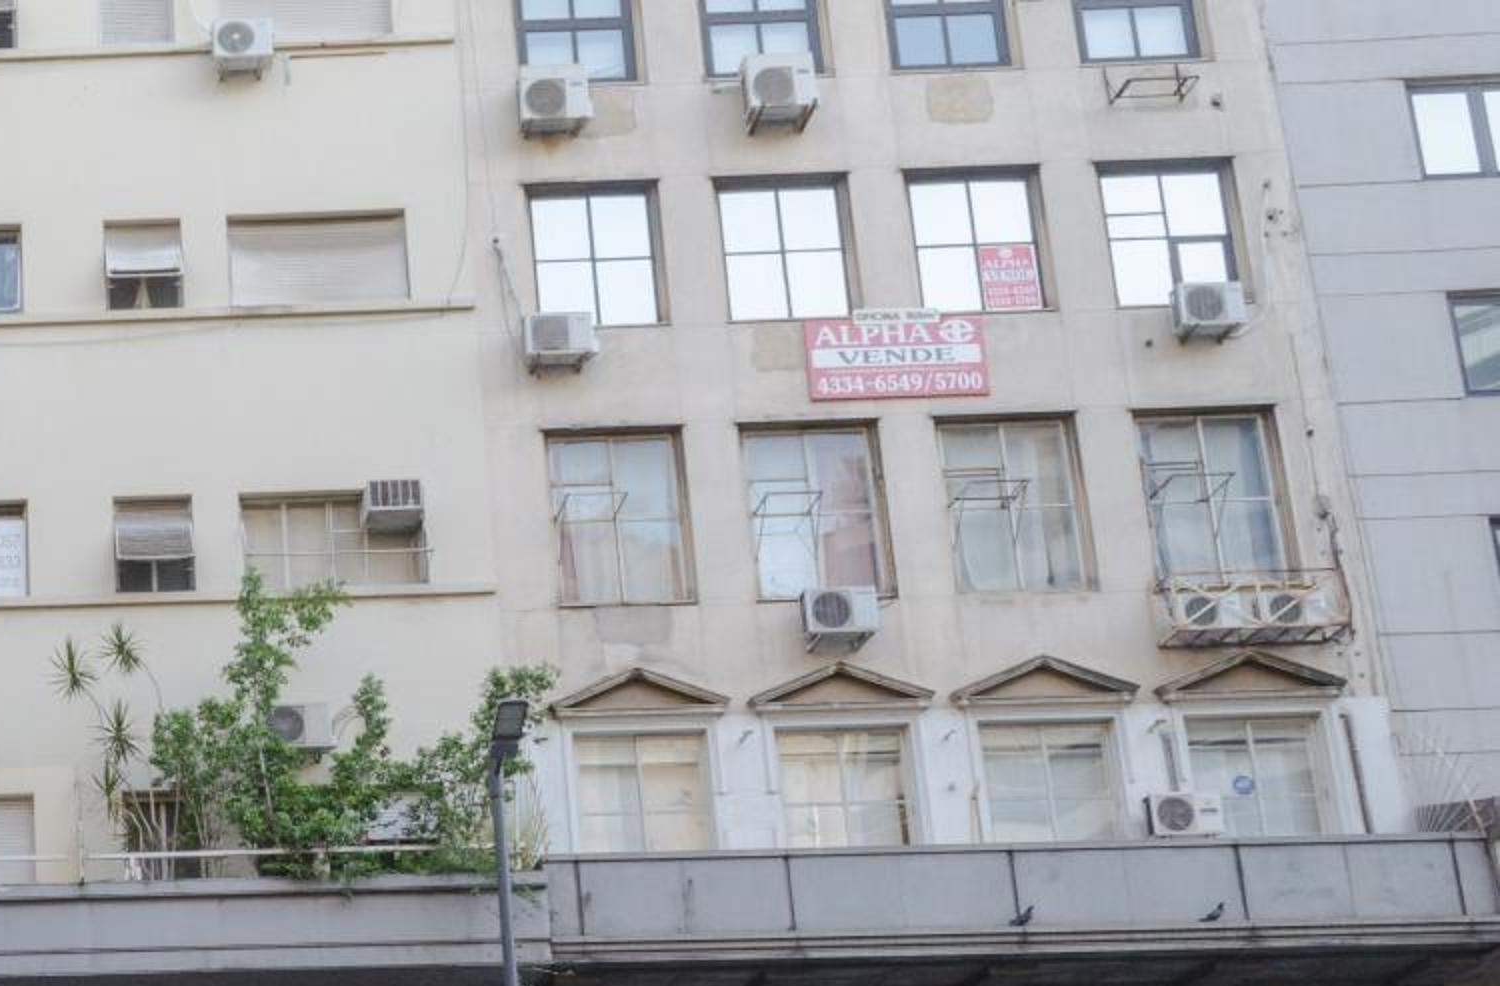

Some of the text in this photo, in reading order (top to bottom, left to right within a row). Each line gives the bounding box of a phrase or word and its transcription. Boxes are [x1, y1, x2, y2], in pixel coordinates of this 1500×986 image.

[815, 322, 933, 346] ALPHA
[837, 347, 956, 366] VENDE
[818, 371, 982, 395] 4334-6549/5700
